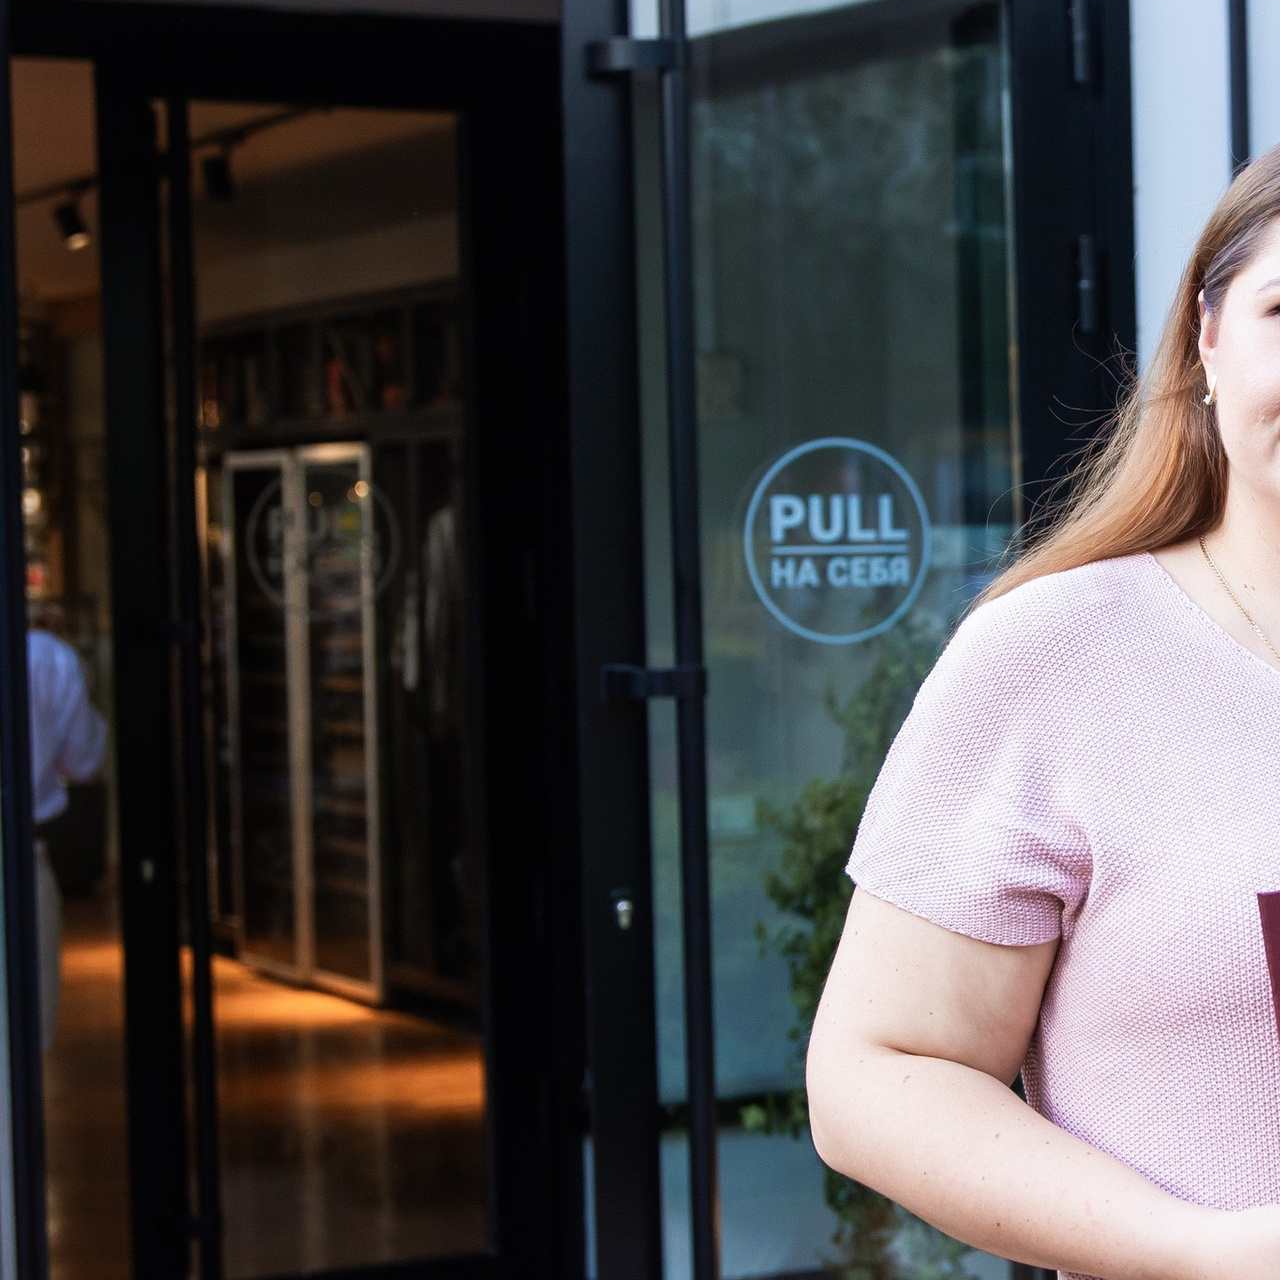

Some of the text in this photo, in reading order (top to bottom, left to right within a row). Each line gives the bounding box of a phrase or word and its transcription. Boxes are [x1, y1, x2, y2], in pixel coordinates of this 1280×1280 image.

[769, 493, 909, 544] PULL
[770, 556, 911, 589] НА СЕБЯ
